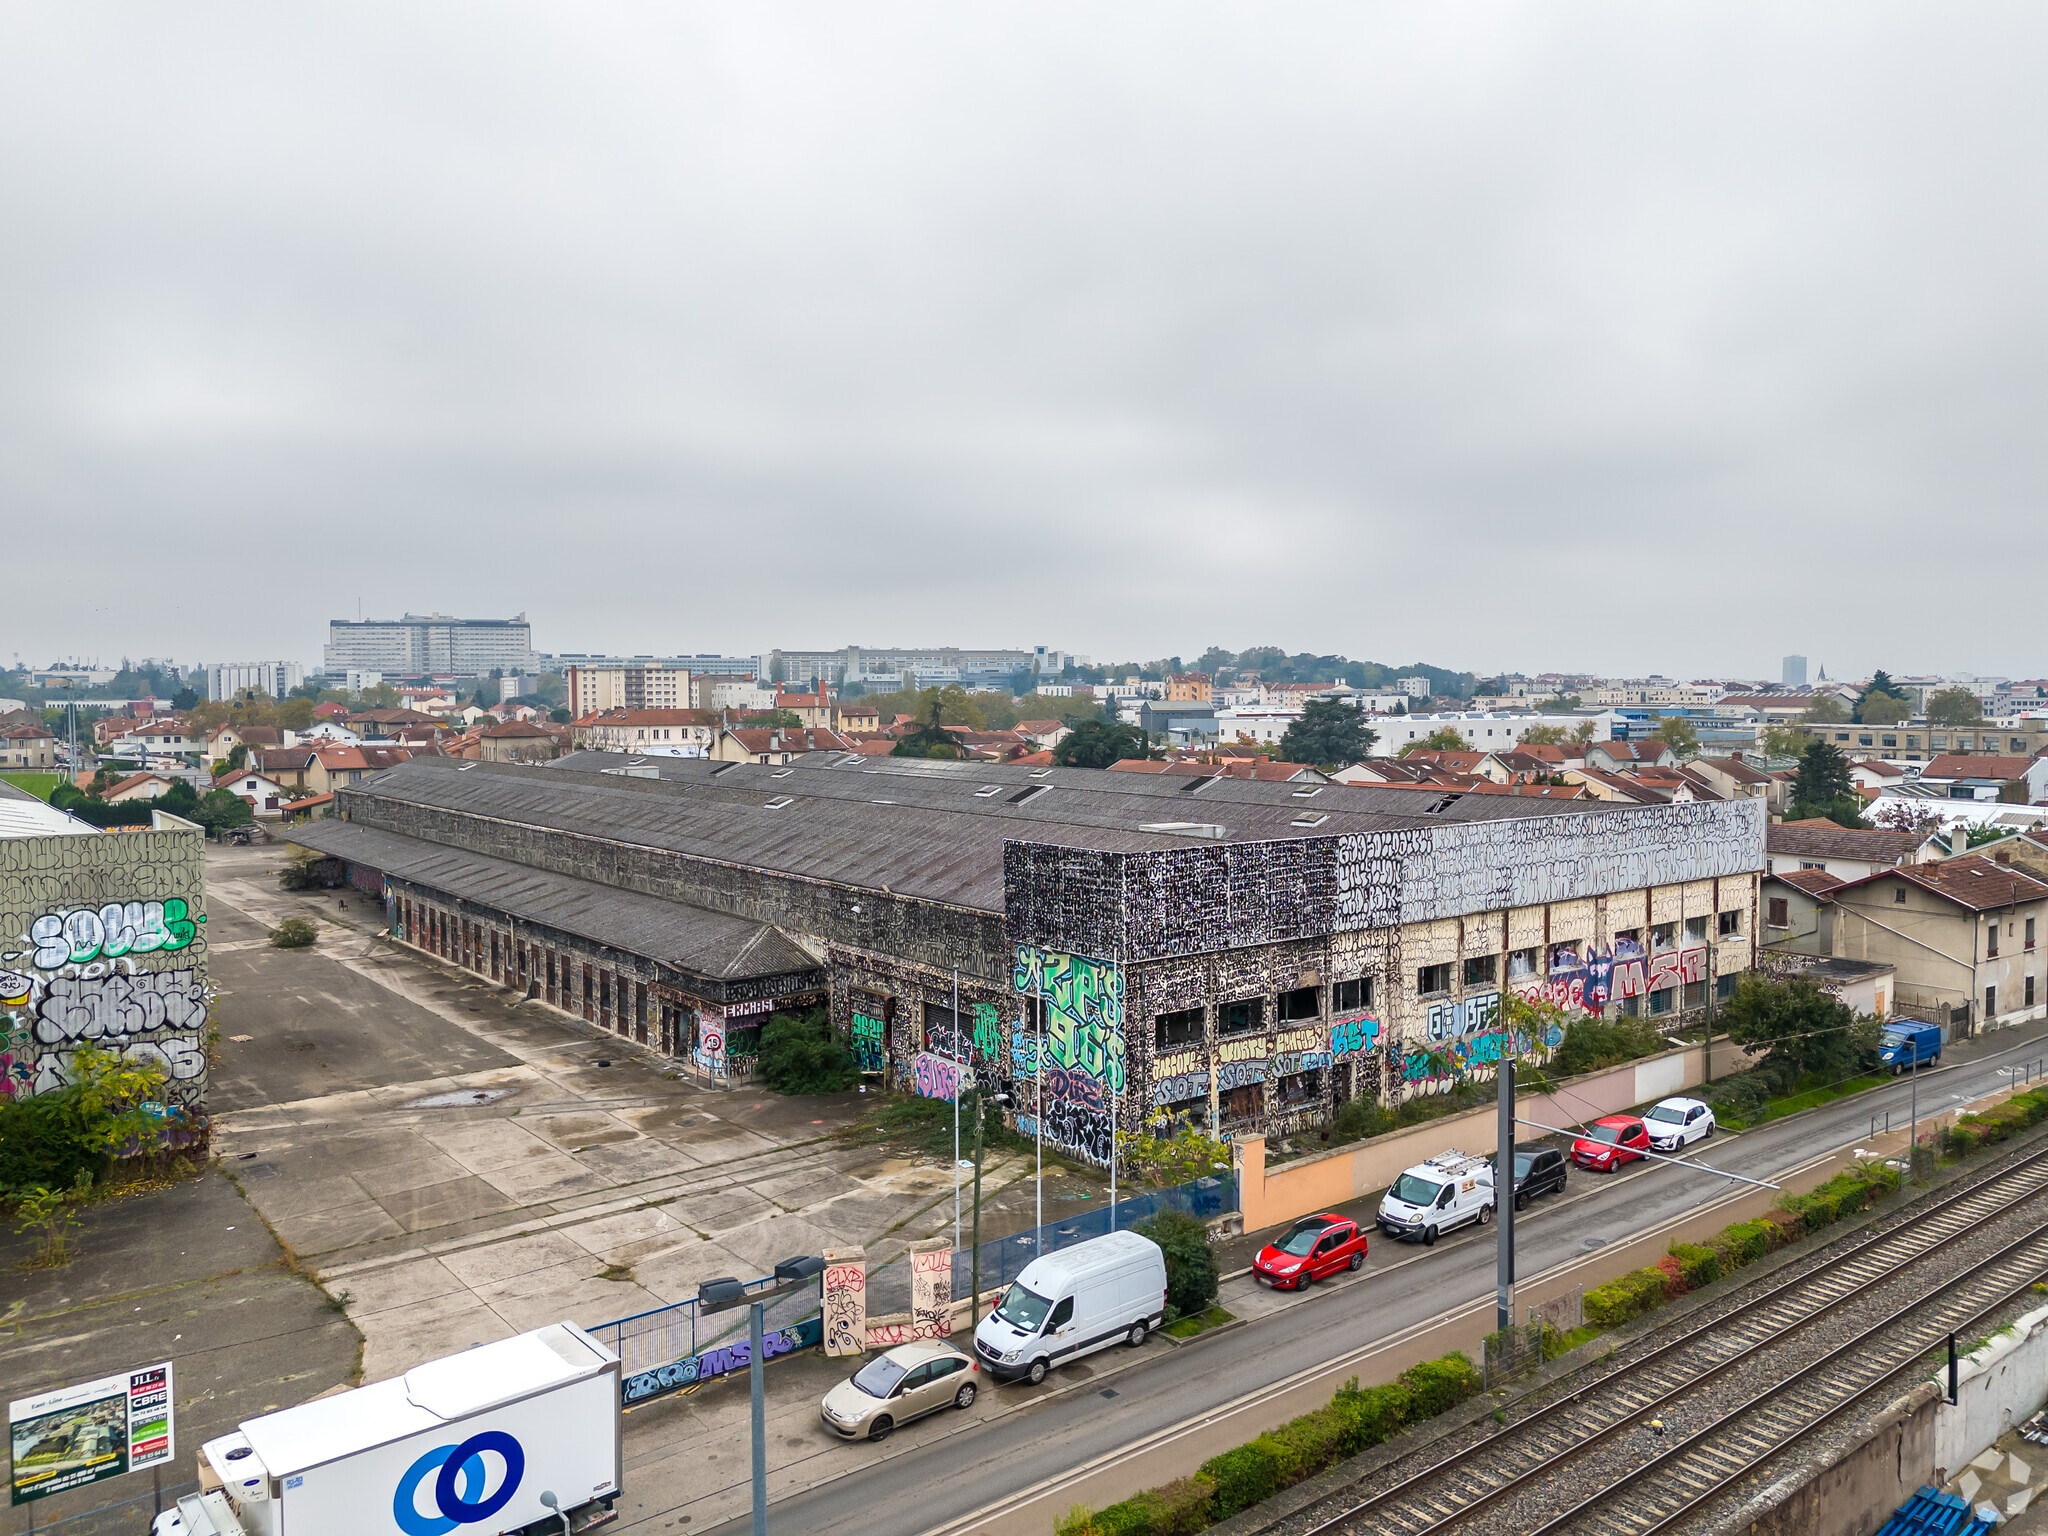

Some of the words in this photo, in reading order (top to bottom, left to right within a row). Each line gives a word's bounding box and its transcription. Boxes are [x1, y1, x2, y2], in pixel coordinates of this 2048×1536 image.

[1609, 946, 1707, 1001] MSR
[708, 1037, 718, 1048] 15
[1155, 1072, 1211, 1106] SOT
[1218, 1060, 1270, 1091] SOT
[1271, 1052, 1301, 1078] SOT
[132, 1391, 167, 1408] CBRE
